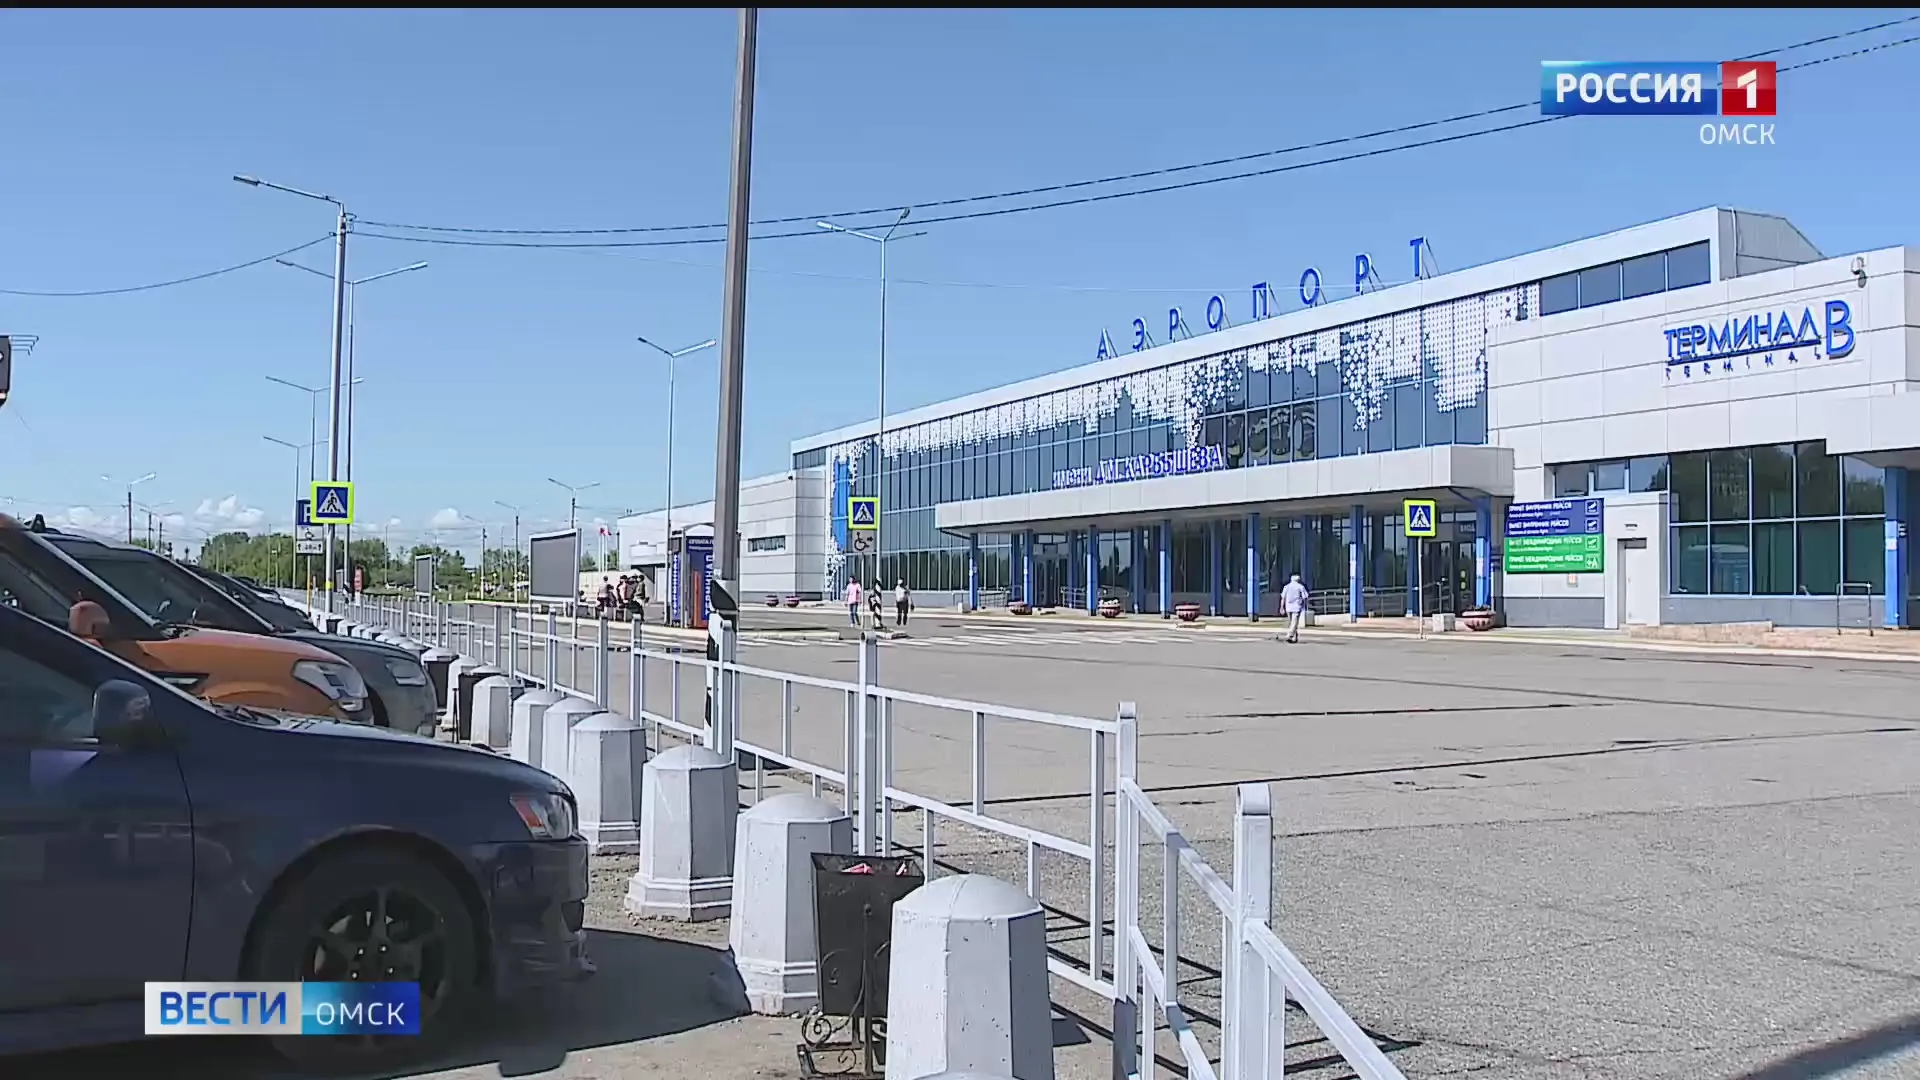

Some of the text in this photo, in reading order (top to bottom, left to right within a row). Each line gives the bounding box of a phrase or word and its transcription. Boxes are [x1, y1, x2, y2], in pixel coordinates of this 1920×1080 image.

[1097, 236, 1427, 359] АЭРОПОРТ
[1663, 306, 1821, 359] ТЕРМИНАЛ
[1664, 346, 1822, 381] TERMINAL
